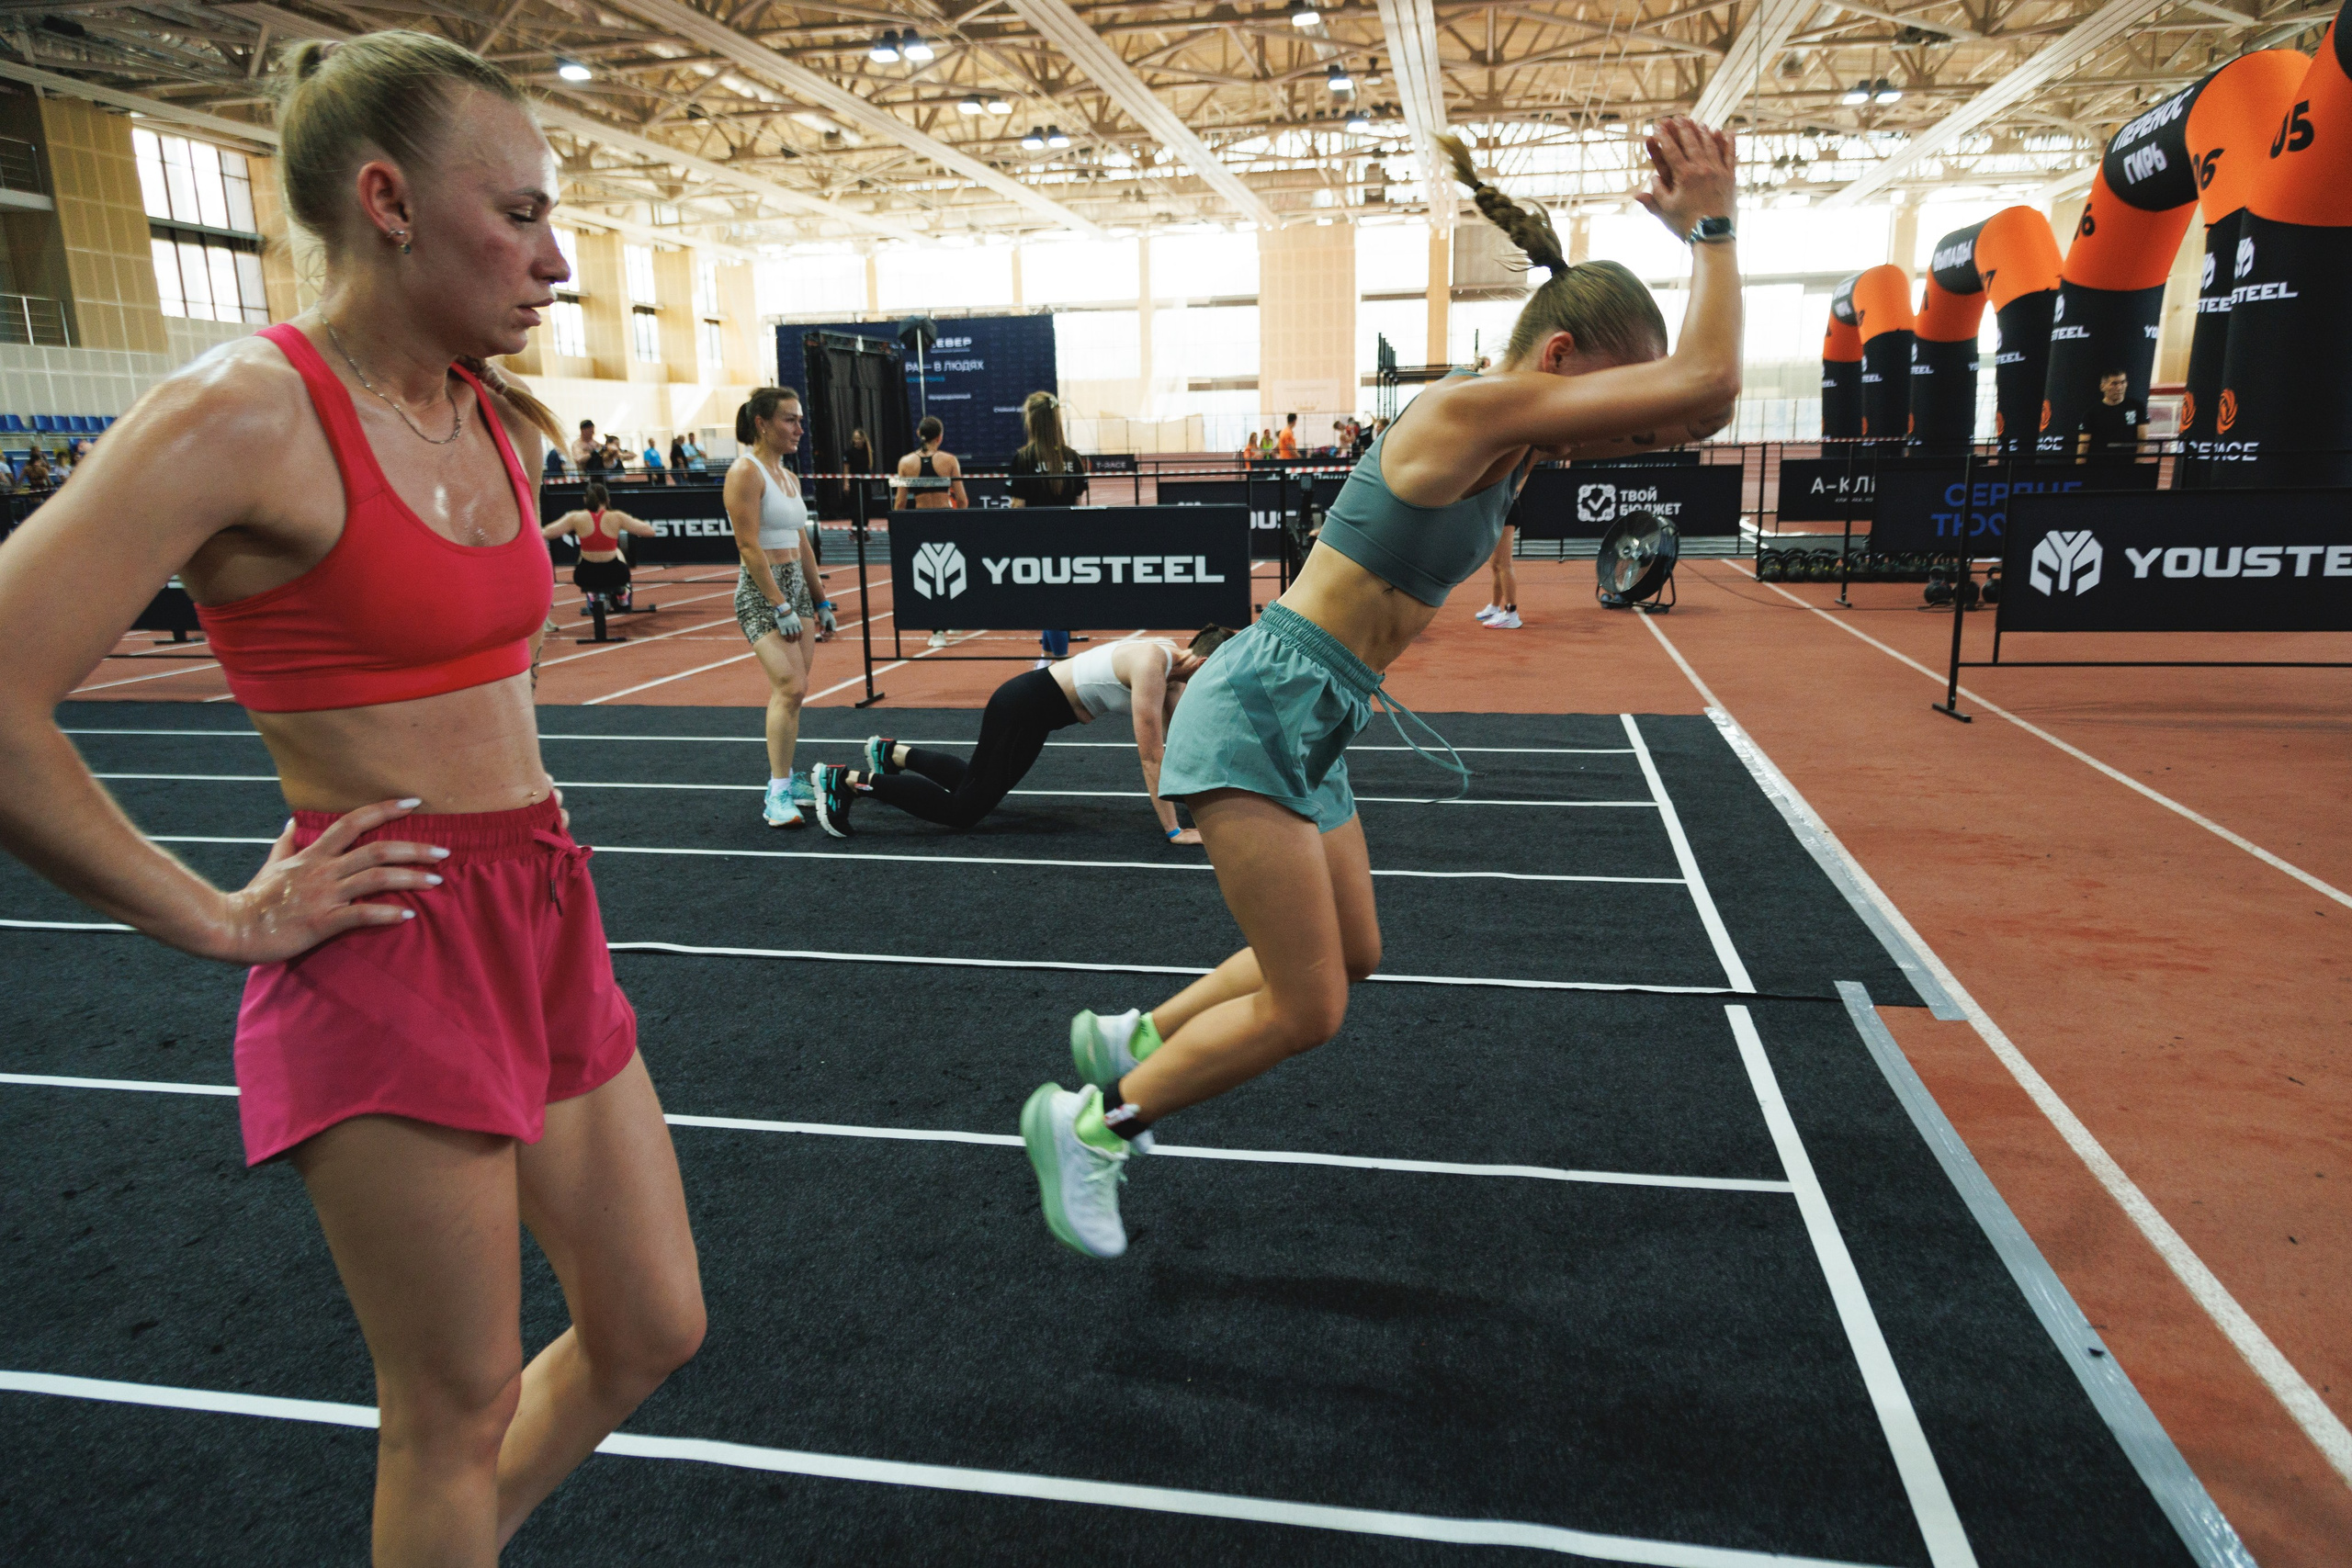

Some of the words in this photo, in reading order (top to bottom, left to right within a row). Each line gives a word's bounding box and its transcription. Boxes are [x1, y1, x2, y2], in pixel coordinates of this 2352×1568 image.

[2111, 86, 2195, 154] ПЕРЕНОС
[2269, 99, 2314, 159] 05
[2122, 141, 2167, 185] ГИРЬ
[944, 359, 985, 372] ЛЮДЯХ
[1035, 462, 1074, 473] JUGE
[1620, 486, 1657, 502] ТВОЙ
[647, 518, 734, 538] STEEL
[981, 556, 1225, 584] YOUSTEEL
